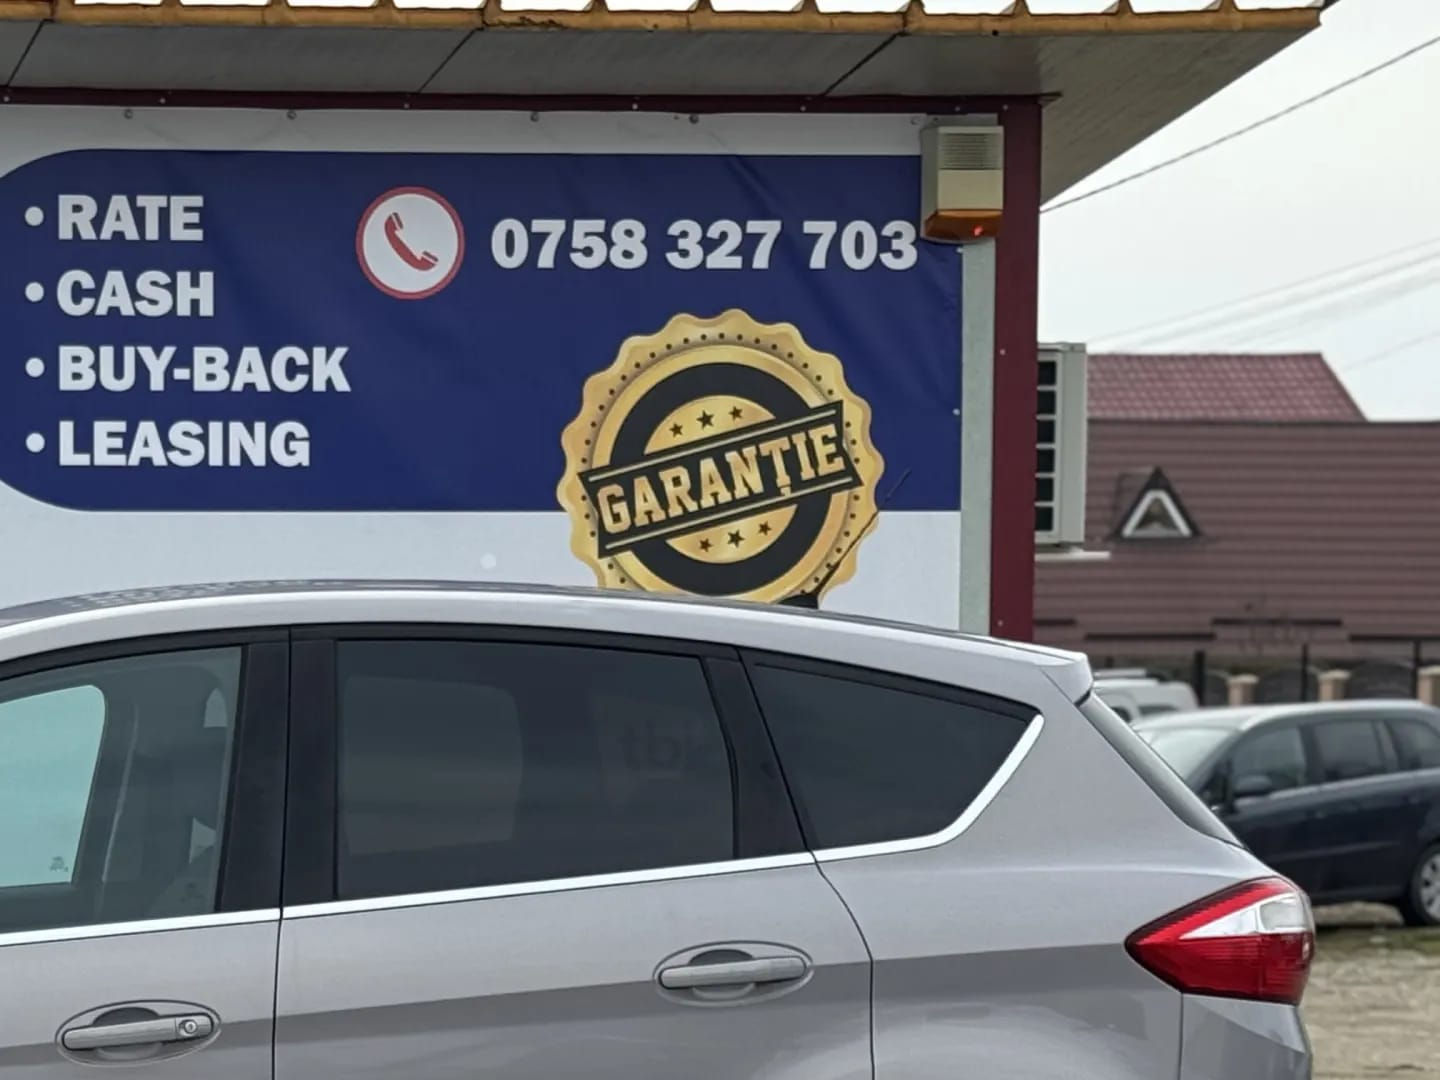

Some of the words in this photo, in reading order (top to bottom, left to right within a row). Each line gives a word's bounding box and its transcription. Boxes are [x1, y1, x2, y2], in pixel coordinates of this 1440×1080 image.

[56, 193, 205, 242] RATE
[490, 217, 649, 270] 0758
[664, 218, 782, 270] 327
[803, 219, 918, 271] 703
[56, 268, 215, 318] CASH
[57, 345, 352, 394] BUY-BACK
[58, 420, 311, 469] LEASING
